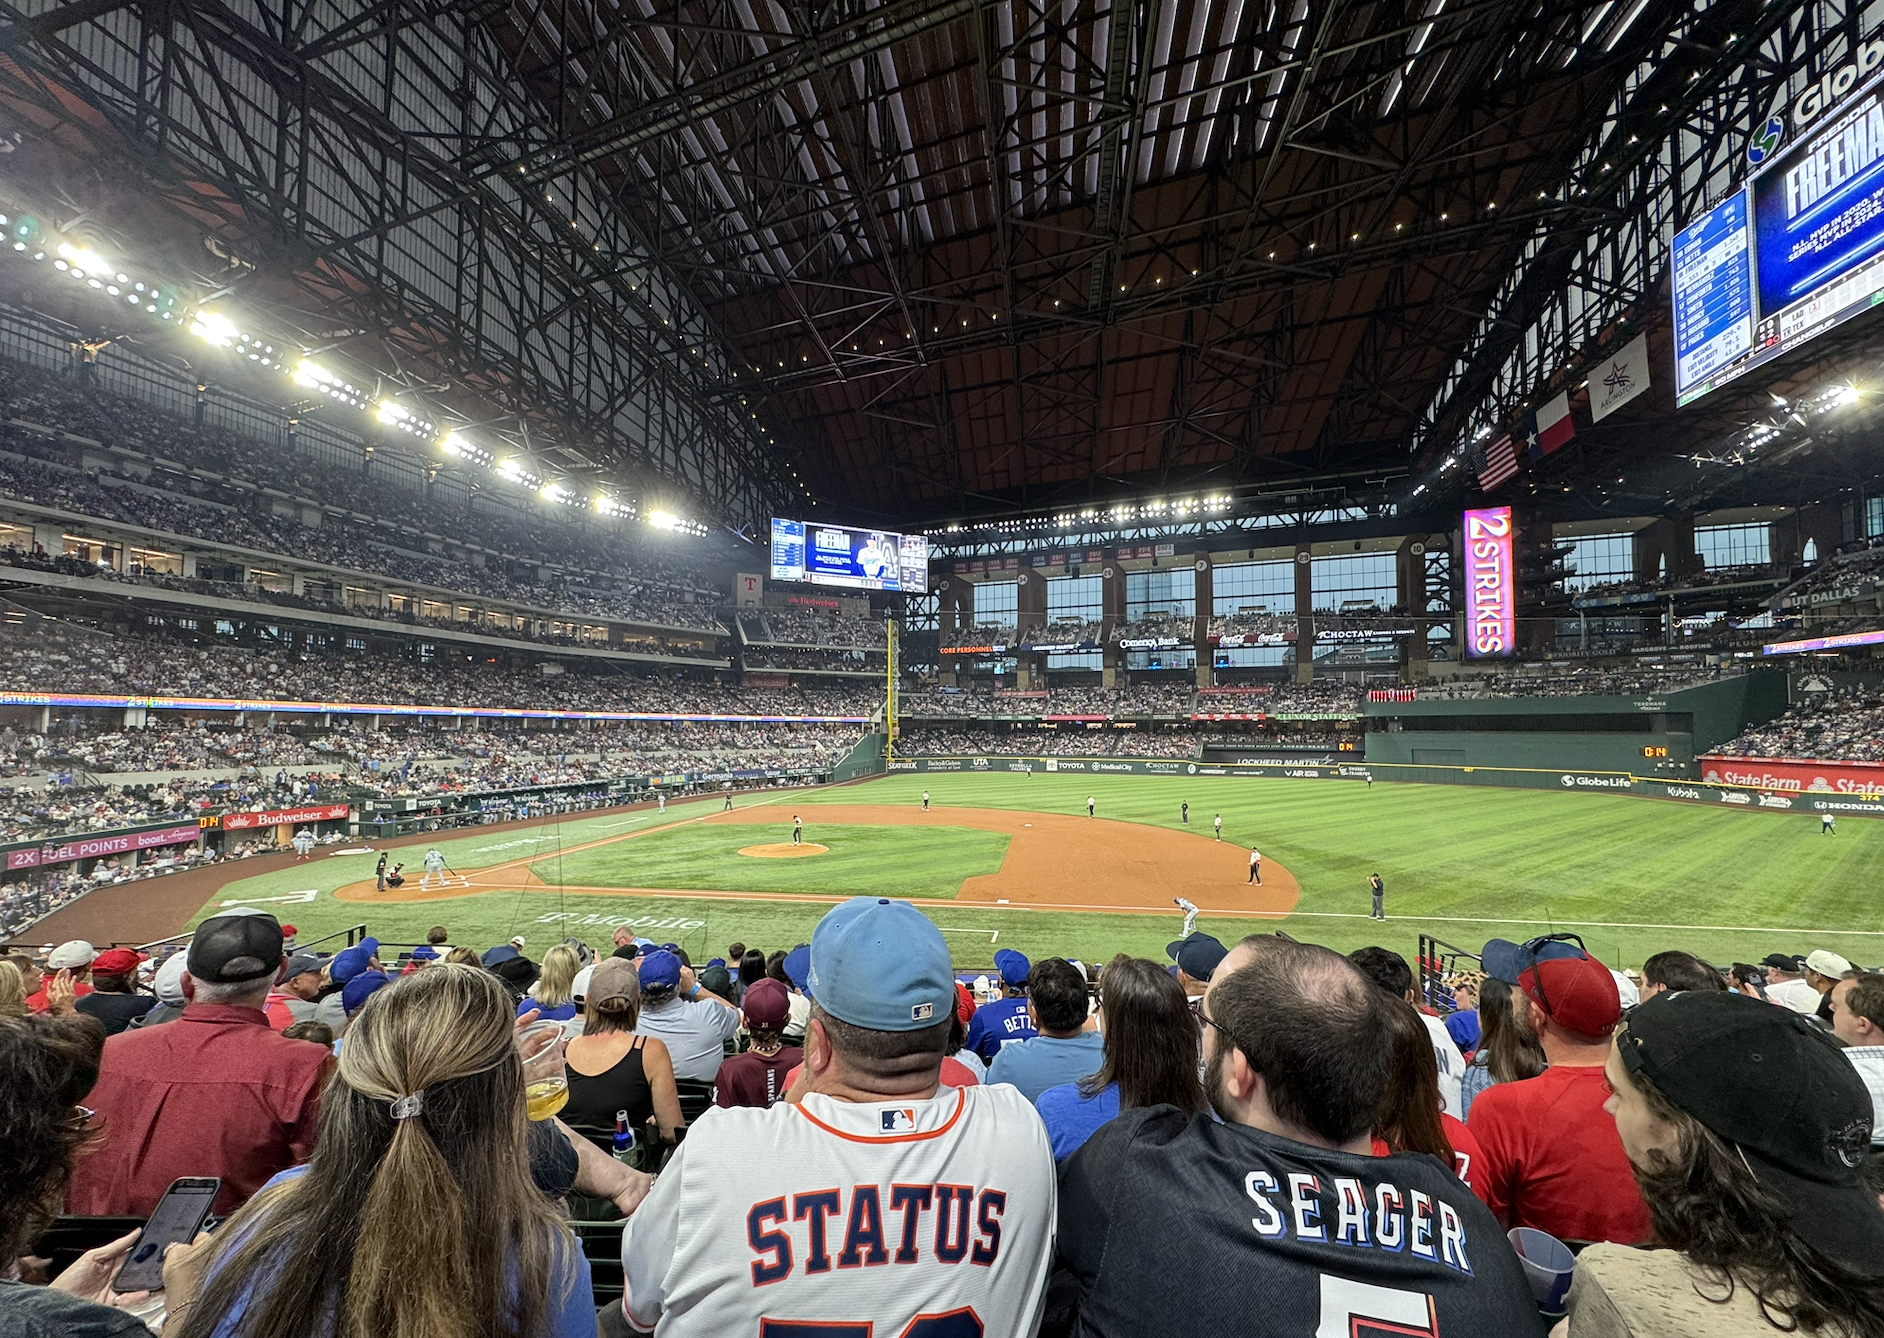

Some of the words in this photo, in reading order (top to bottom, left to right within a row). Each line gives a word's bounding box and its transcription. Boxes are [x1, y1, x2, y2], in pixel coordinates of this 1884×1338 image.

[1808, 94, 1877, 154] FREDDIE
[1810, 223, 1830, 240] MVP
[1831, 216, 1842, 226] IN
[1788, 240, 1819, 262] SERIES
[1820, 225, 1840, 242] MVP
[1842, 218, 1852, 228] IN
[1781, 318, 1836, 351] CHANGEUP
[1600, 381, 1636, 409] ARLINGTON
[1470, 514, 1510, 540] 2
[1474, 541, 1503, 654] STRIKES
[1792, 595, 1809, 607] UT
[1811, 586, 1860, 604] DALLAS
[1158, 636, 1180, 646] Bank
[1324, 630, 1372, 639] CHOCTAW
[1830, 636, 1862, 646] STRIKES
[973, 758, 989, 766] UTA
[702, 772, 734, 780] Germania
[1576, 776, 1609, 787] Globe
[1610, 778, 1632, 788] Life
[1724, 771, 1760, 787] State
[1761, 774, 1801, 791] Farm
[1668, 786, 1700, 799] Kubota
[1828, 802, 1884, 811] HONDA
[257, 812, 322, 825] Budweiser
[14, 852, 34, 866] 2X
[80, 840, 128, 854] POINTS
[568, 912, 708, 929] Mobile
[766, 1068, 776, 1102] SPARTANS
[1244, 1170, 1475, 1278] SEAGER
[746, 1184, 1006, 1288] STATUS
